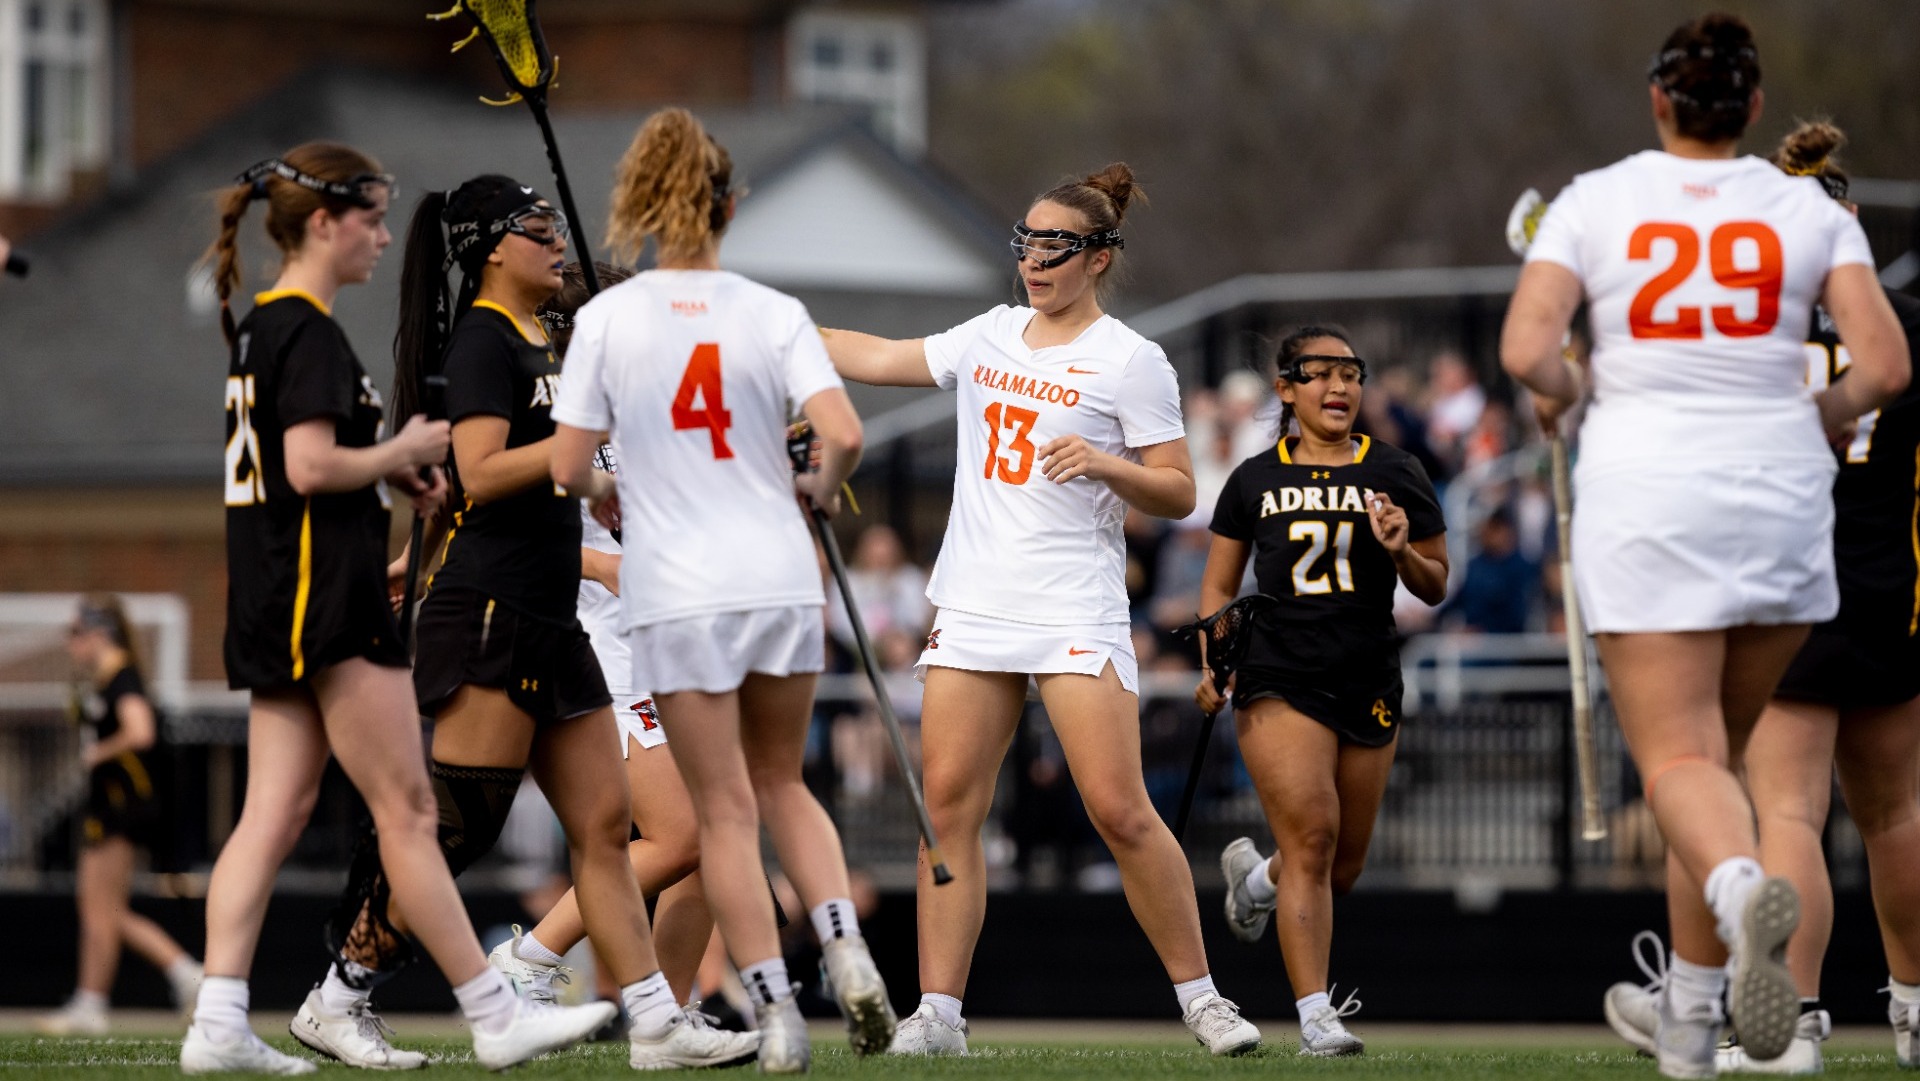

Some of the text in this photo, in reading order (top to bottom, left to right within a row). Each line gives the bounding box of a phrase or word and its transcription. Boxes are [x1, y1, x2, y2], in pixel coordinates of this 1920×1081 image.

[451, 221, 479, 234] STX
[456, 232, 480, 253] STX
[1627, 220, 1784, 339] 29
[546, 310, 565, 321] STX
[670, 342, 735, 461] 4
[973, 364, 1080, 408] KALAMAZOO
[984, 401, 1040, 486] 13
[1289, 520, 1355, 597] 21
